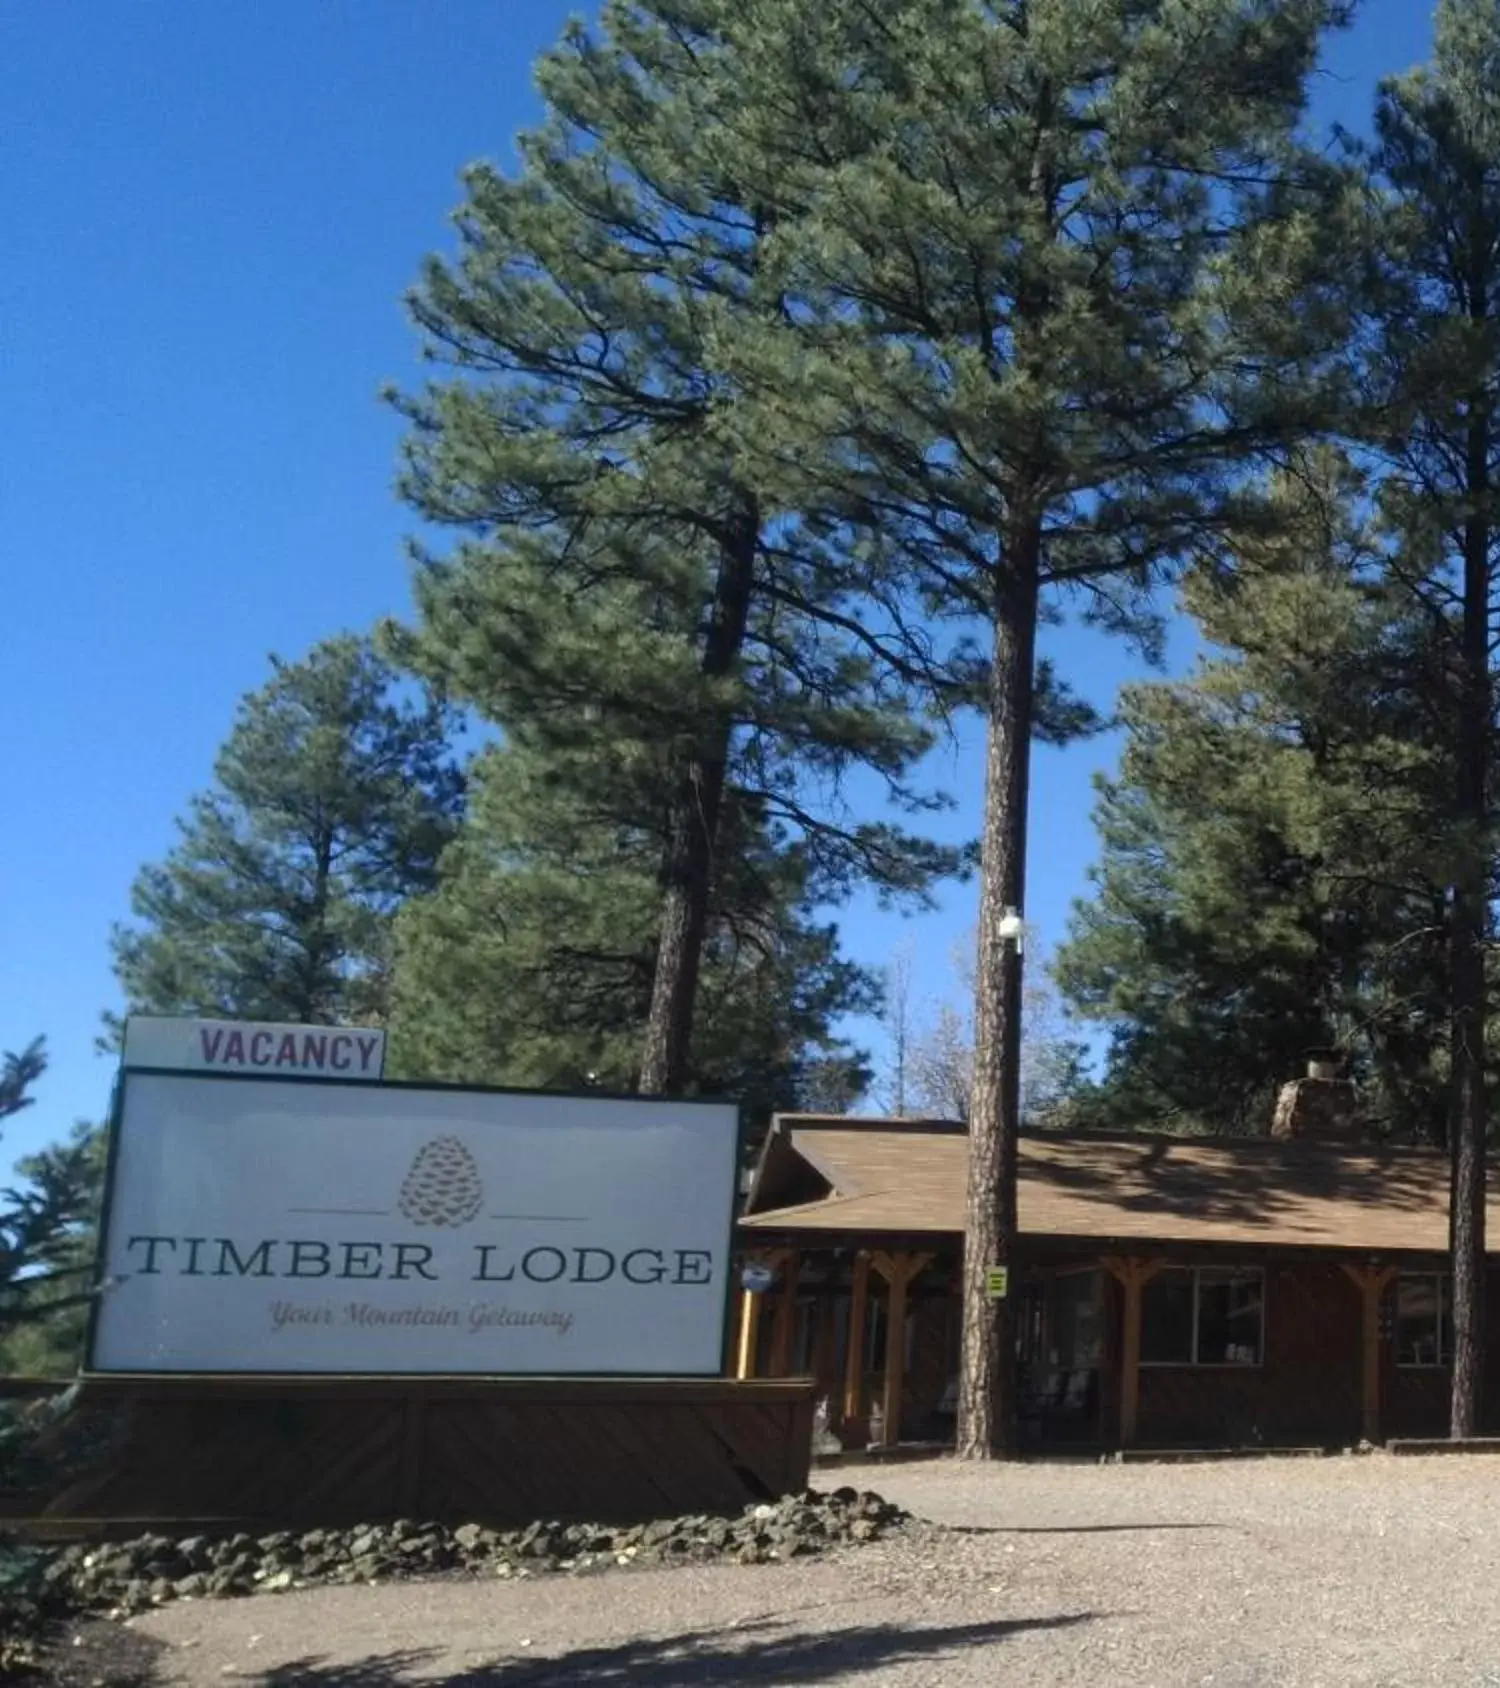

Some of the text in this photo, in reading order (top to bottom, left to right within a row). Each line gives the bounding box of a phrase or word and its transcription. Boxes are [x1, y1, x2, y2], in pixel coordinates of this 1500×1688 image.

[200, 1027, 379, 1071] VACANCY
[127, 1236, 713, 1285] TIMBER LODGE
[268, 1301, 574, 1334] Your Mountain Getaway
